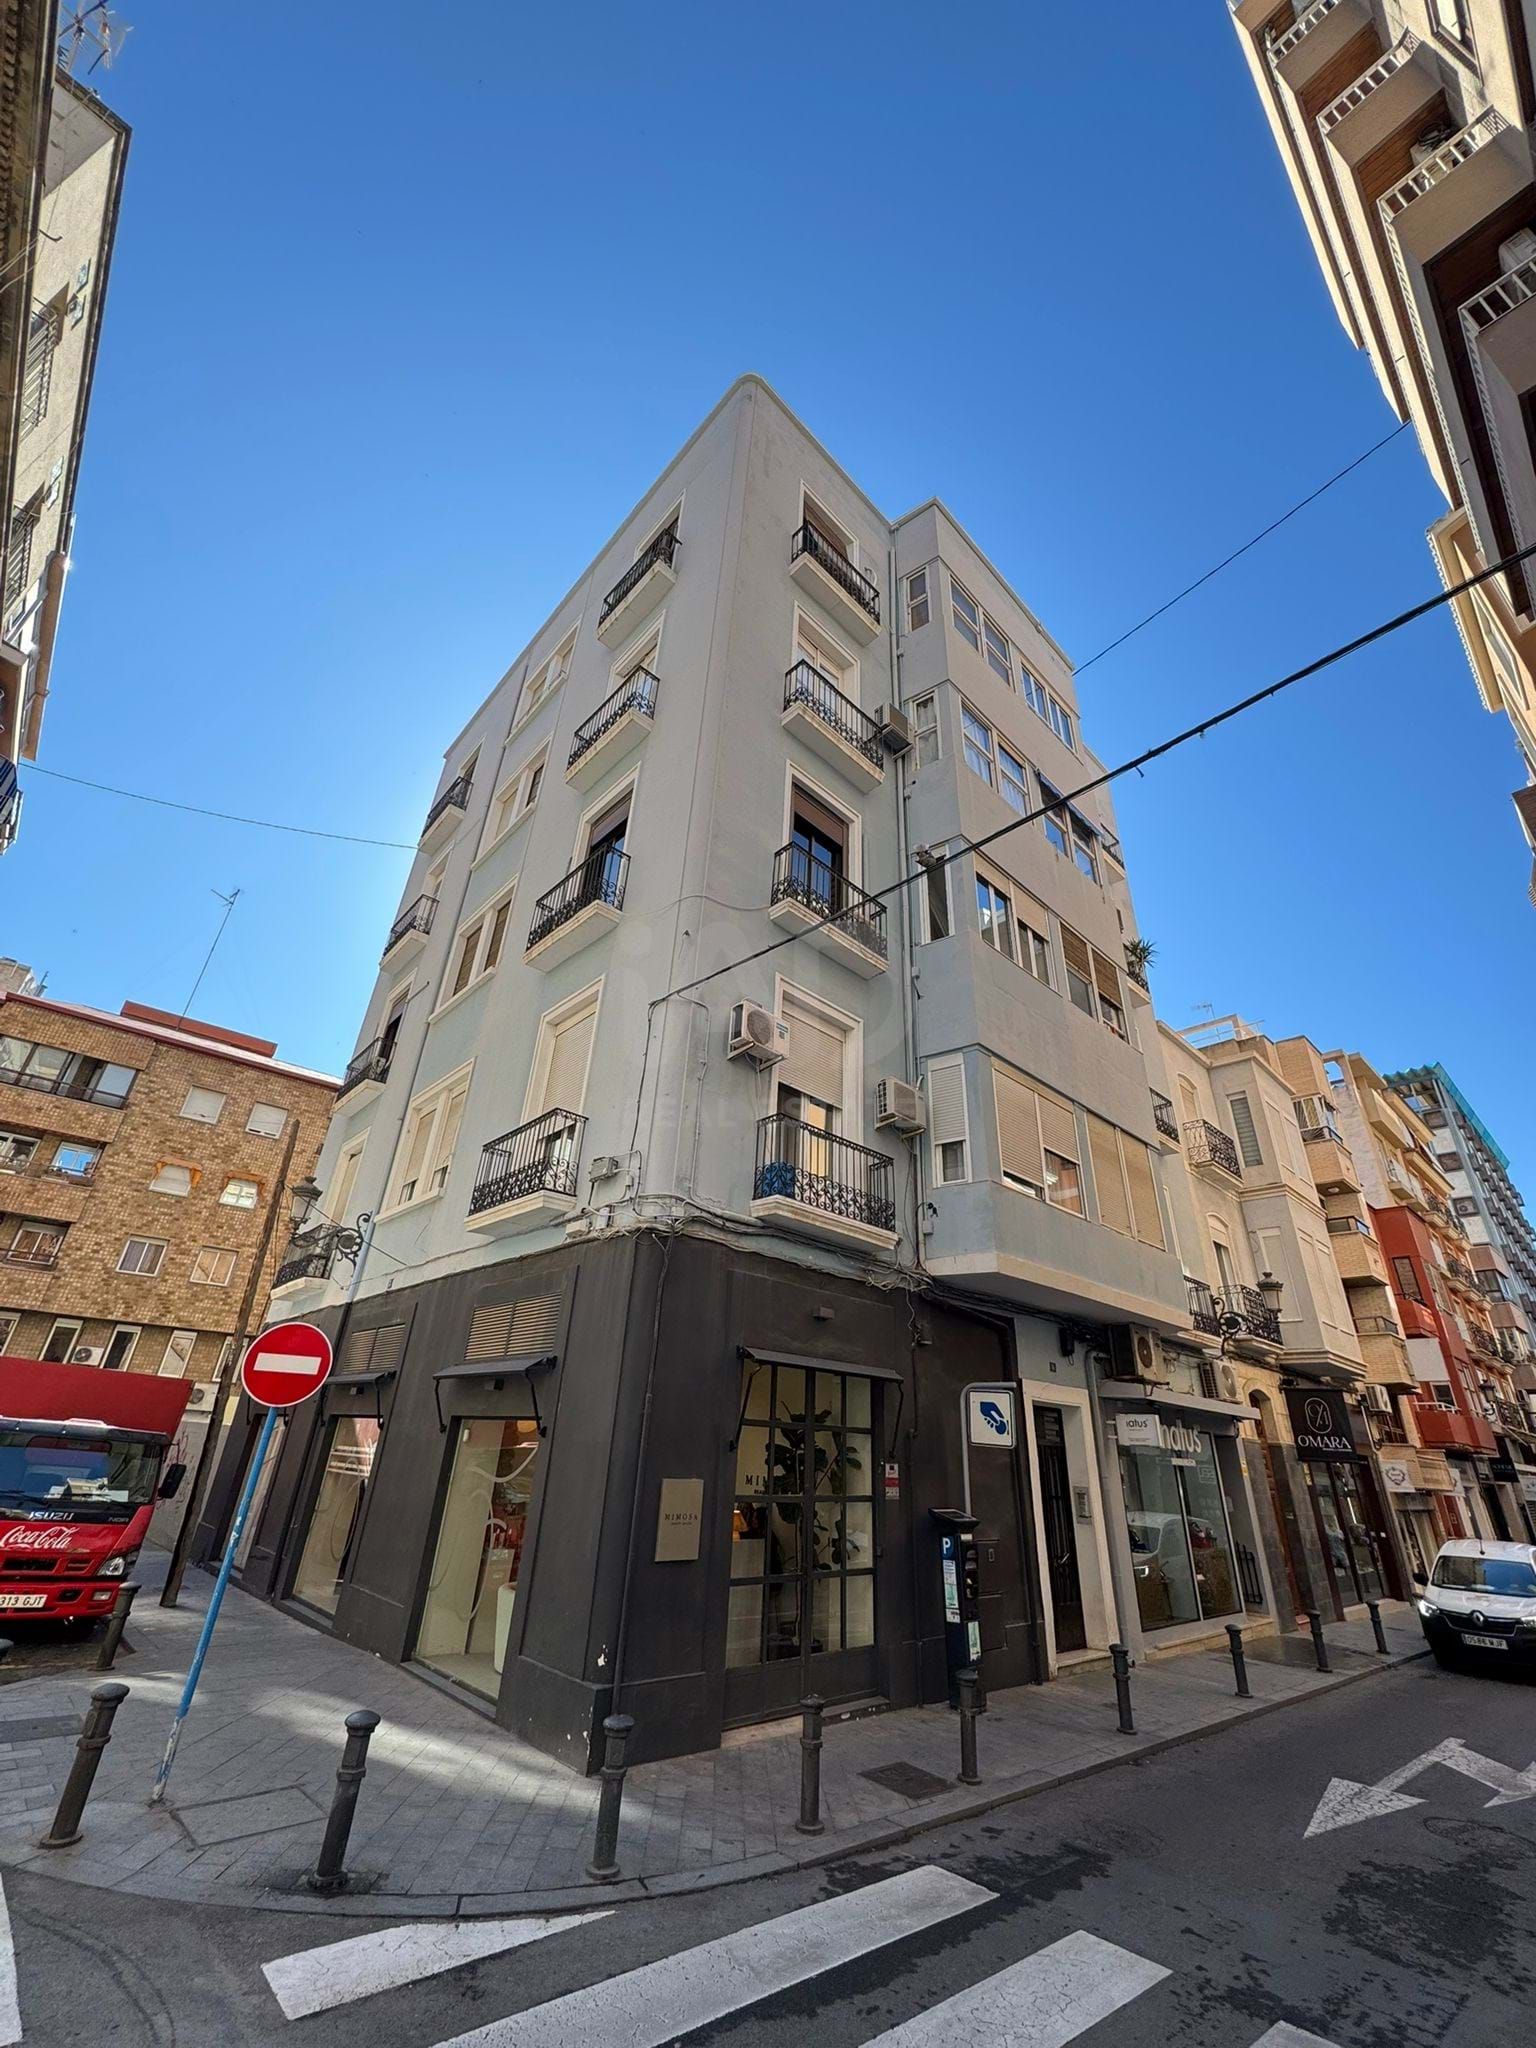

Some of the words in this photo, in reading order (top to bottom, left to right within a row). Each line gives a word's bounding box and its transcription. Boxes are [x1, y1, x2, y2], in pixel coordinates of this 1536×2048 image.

[1297, 1434, 1352, 1449] OMARA
[28, 1510, 75, 1521] ISUZU
[664, 1512, 698, 1521] MIMOSA
[942, 1536, 951, 1554] P
[23, 1596, 43, 1607] GJT
